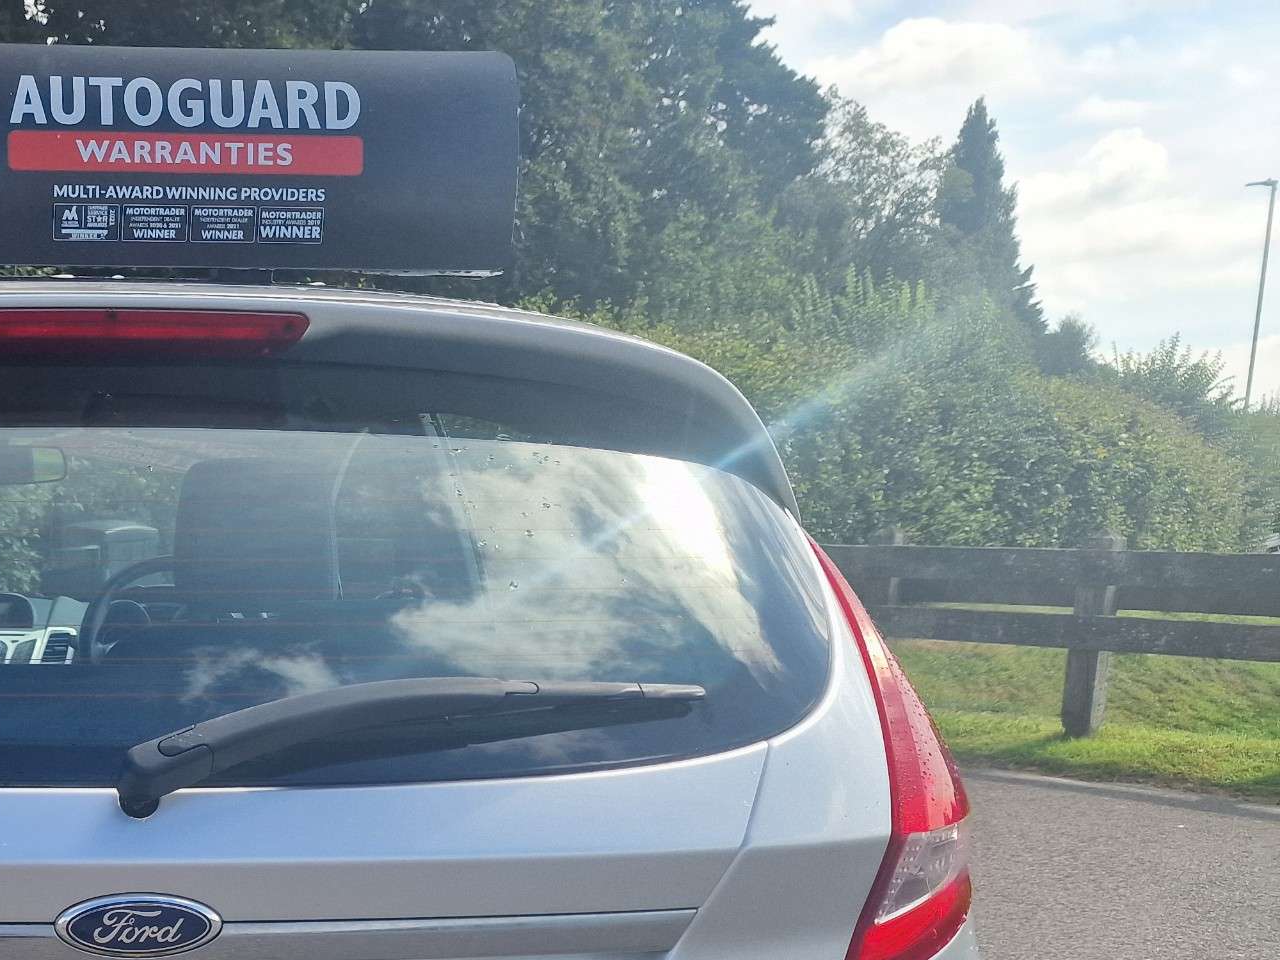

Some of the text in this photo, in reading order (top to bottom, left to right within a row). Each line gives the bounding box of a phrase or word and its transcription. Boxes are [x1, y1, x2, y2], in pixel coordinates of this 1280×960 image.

[10, 74, 361, 130] AUTOGUARD
[75, 138, 294, 166] WARRANTIES
[53, 184, 326, 202] MULTI-AWARD WINNING PROVIDERS
[126, 207, 185, 216] MOTORTRADER
[194, 208, 254, 217] MOTORTRADER
[261, 210, 322, 219] MOTORTRADER
[133, 228, 176, 239] WINNER
[201, 229, 244, 240] WINNER
[260, 226, 321, 239] WINNER
[93, 909, 185, 944] Ford
